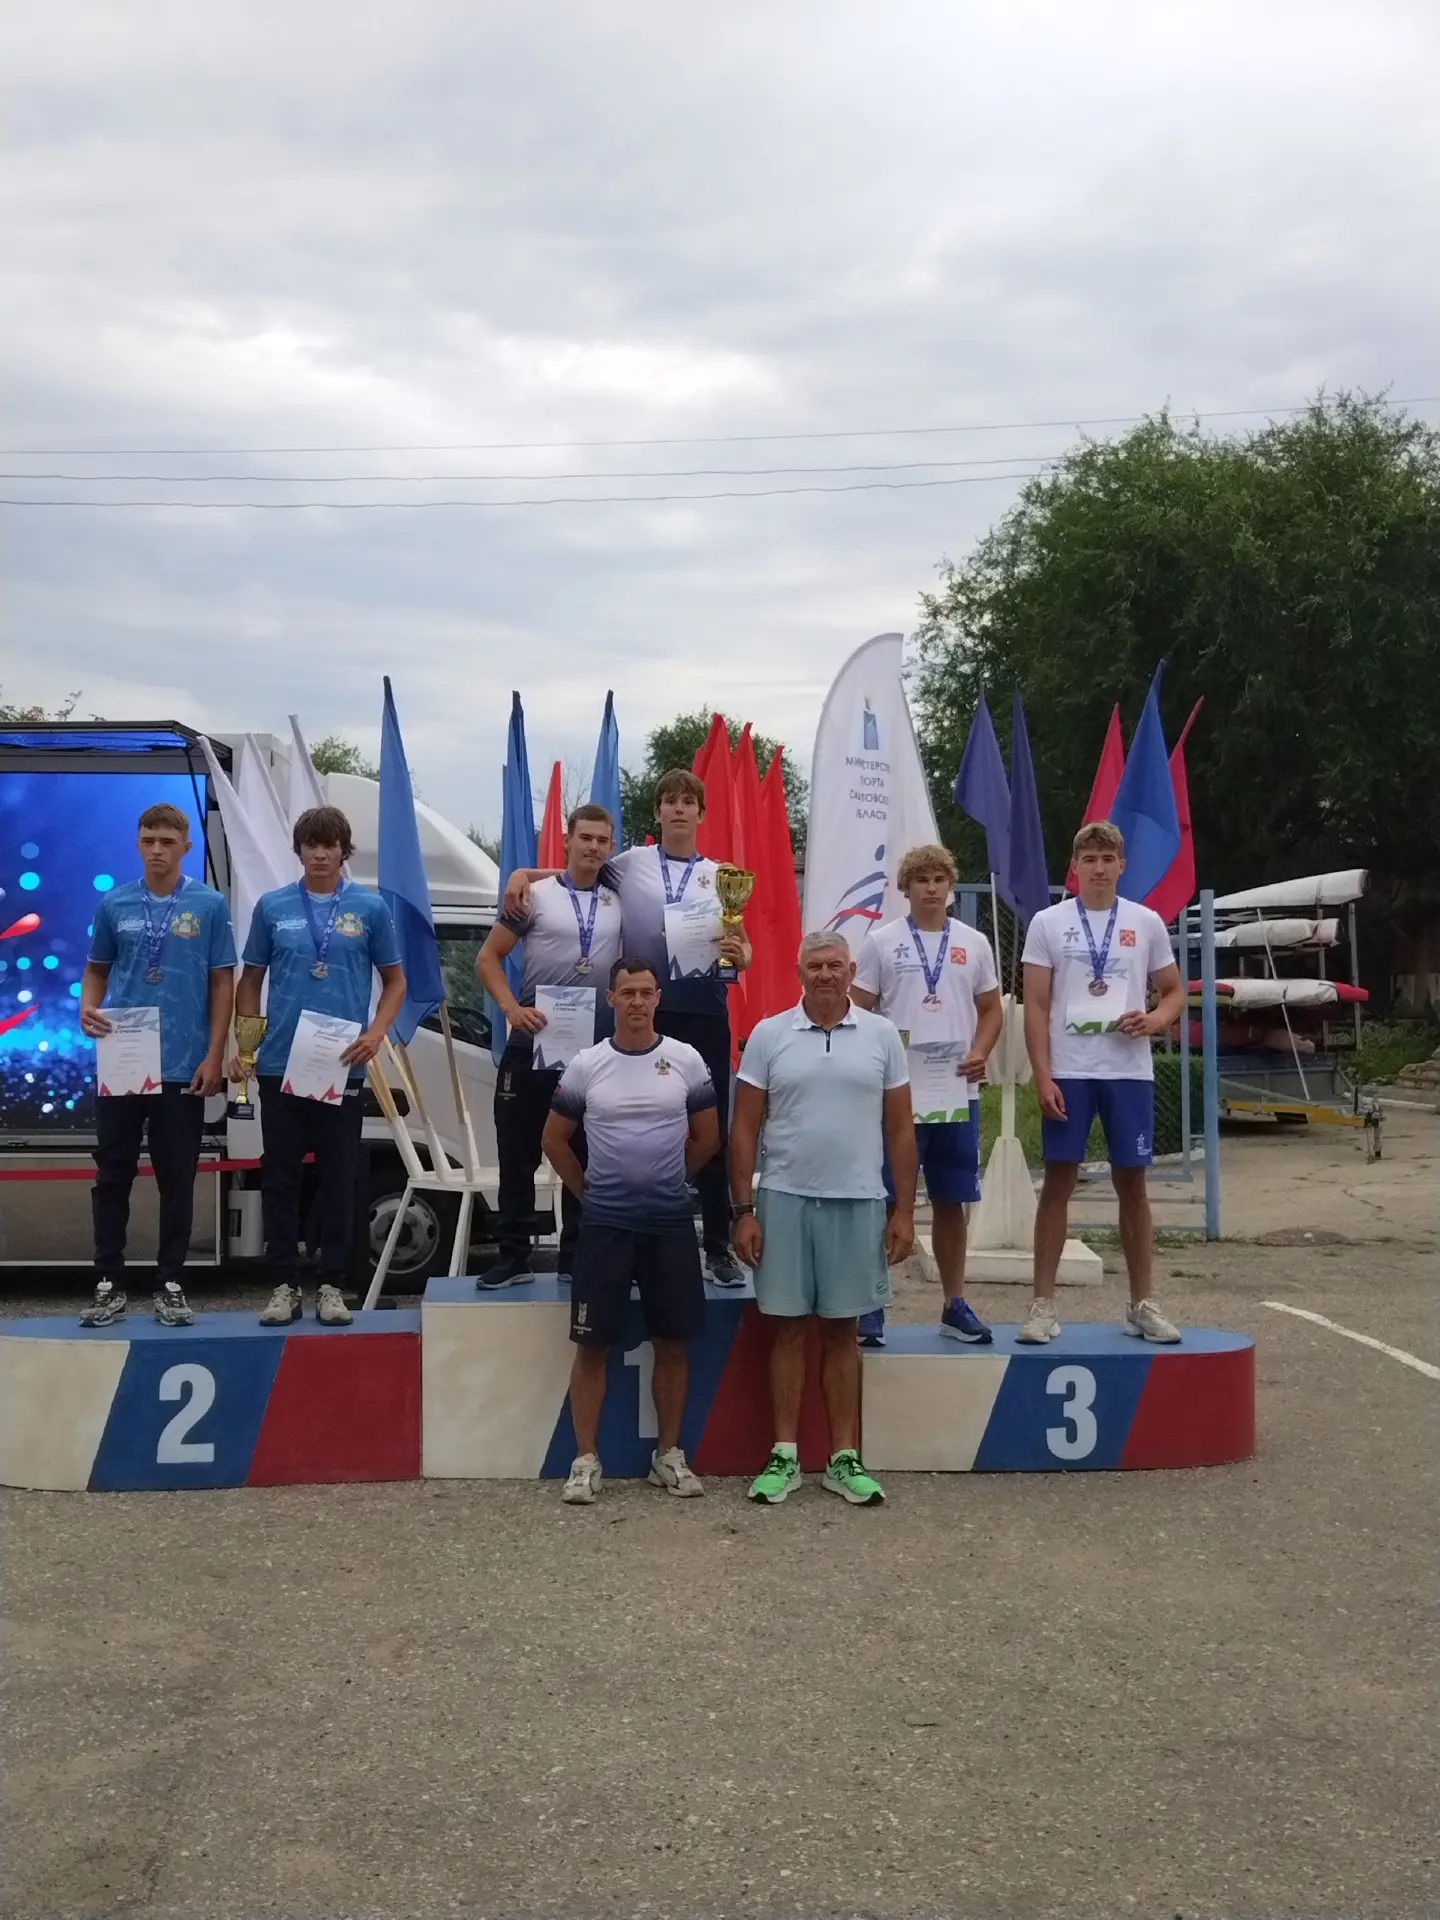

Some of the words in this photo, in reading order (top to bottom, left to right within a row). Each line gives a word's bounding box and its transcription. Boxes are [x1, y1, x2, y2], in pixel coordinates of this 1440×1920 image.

[156, 1363, 216, 1464] 2
[623, 1340, 659, 1439] 1
[1045, 1364, 1098, 1461] 3
